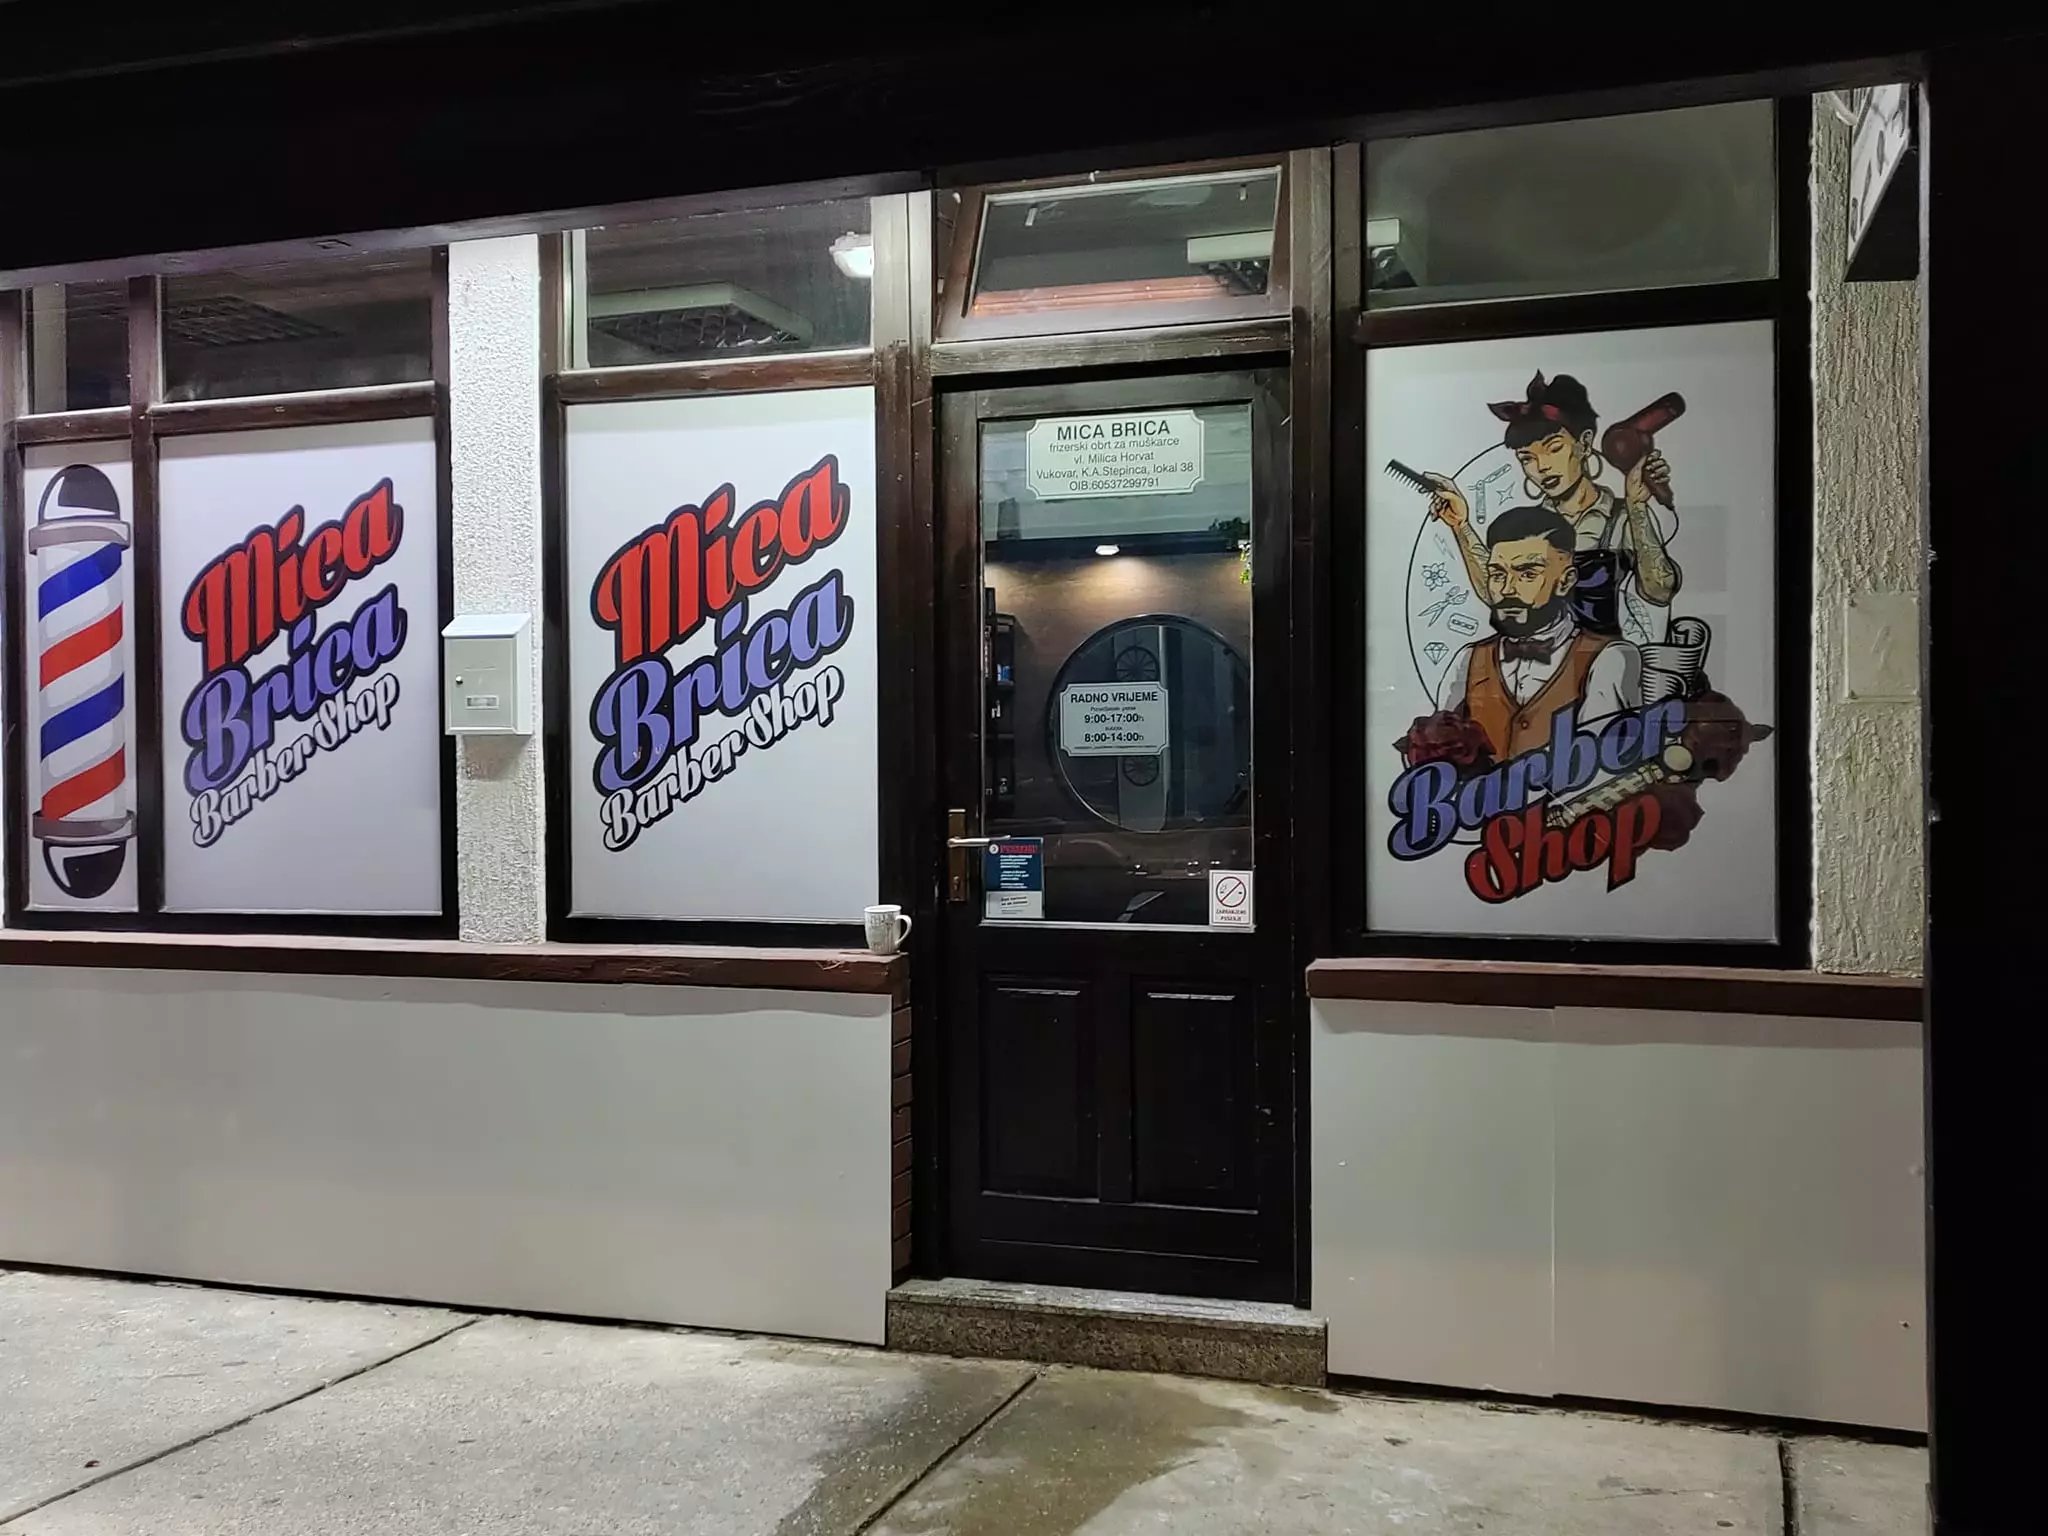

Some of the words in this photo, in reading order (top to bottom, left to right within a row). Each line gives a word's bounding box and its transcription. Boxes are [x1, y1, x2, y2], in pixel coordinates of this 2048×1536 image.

[1036, 468, 1079, 480] Vukovar,
[1152, 462, 1178, 474] lokal
[1180, 461, 1194, 472] 38
[1049, 441, 1088, 453] frizerski
[1090, 439, 1112, 450] obrt
[1114, 440, 1126, 449] za
[1128, 437, 1180, 448] muškarce
[1057, 424, 1104, 441] MICA
[1111, 420, 1171, 437] BRICA
[1087, 453, 1117, 464] Milica
[1120, 451, 1154, 462] Horvat
[182, 478, 403, 678] Mica
[591, 454, 850, 665] Mica
[182, 583, 407, 795] Brica
[590, 568, 854, 796] Brica
[1070, 693, 1108, 703] RADNO
[1111, 691, 1158, 702] VRIJEME
[1388, 696, 1688, 861] Barber
[1465, 794, 1662, 904] Shop
